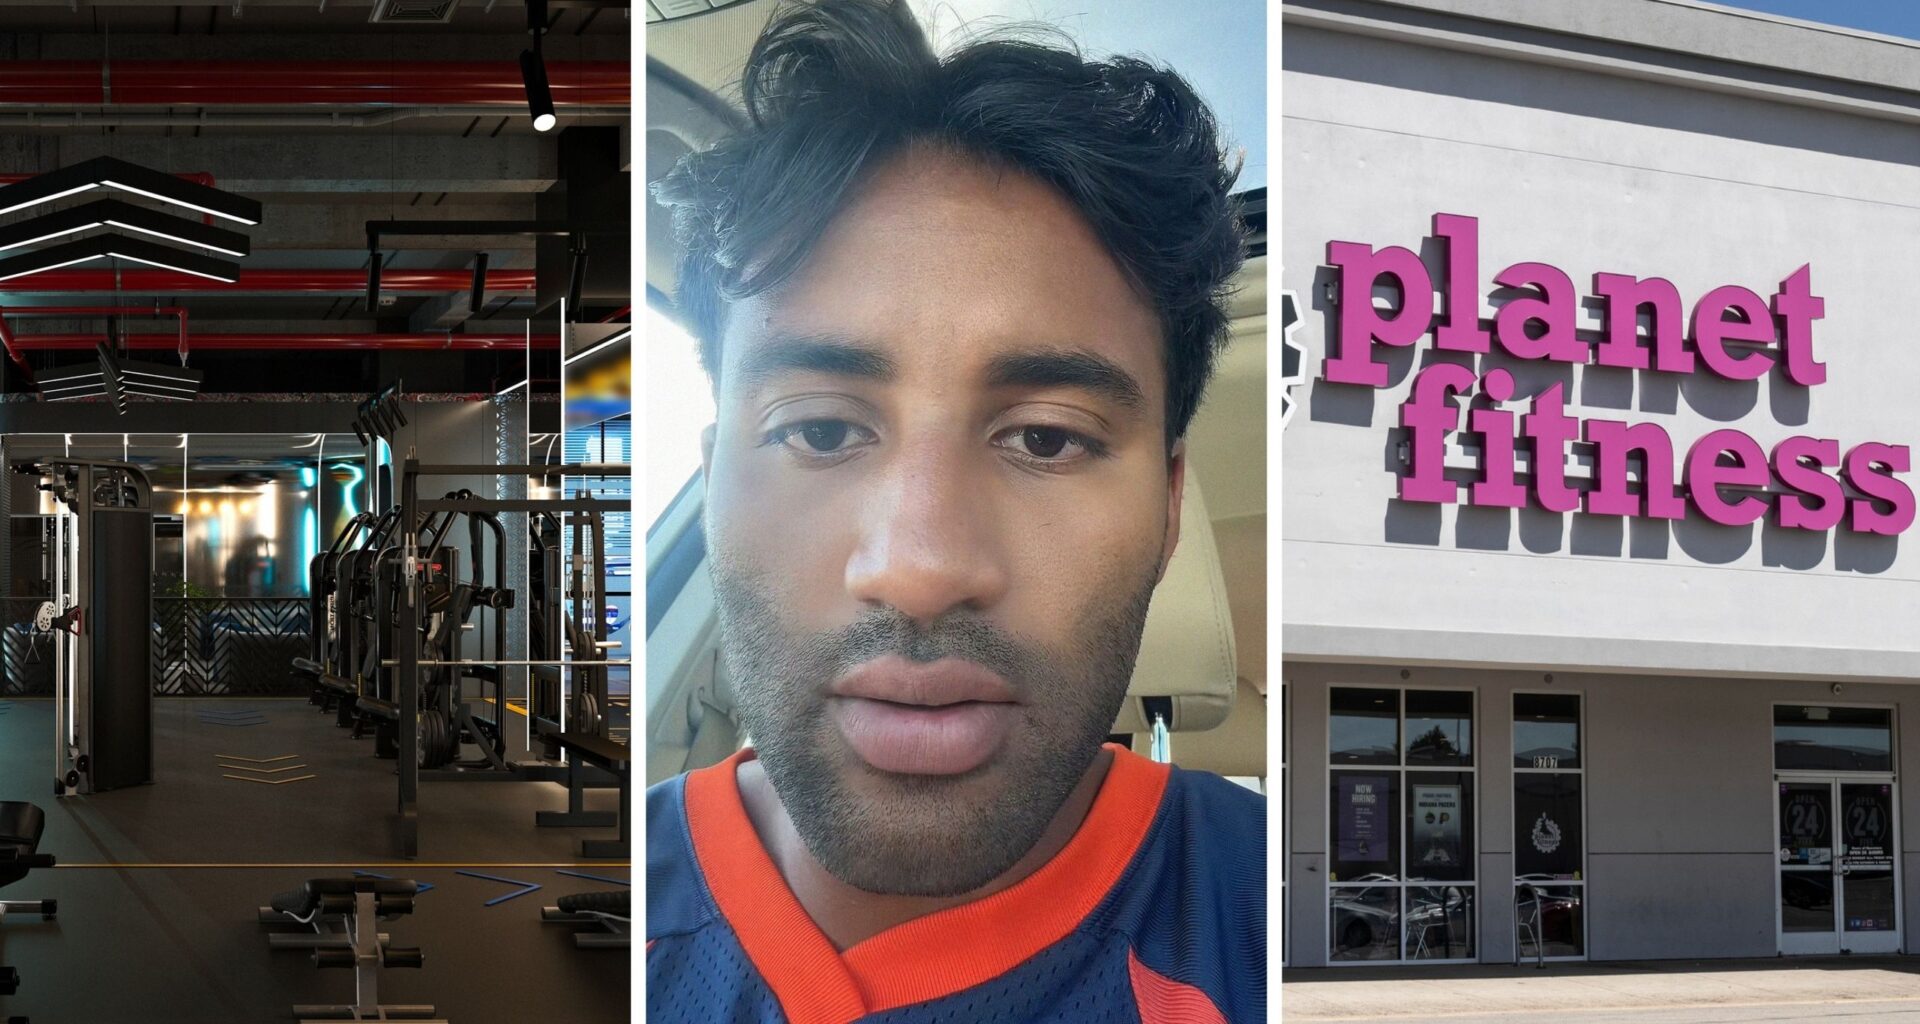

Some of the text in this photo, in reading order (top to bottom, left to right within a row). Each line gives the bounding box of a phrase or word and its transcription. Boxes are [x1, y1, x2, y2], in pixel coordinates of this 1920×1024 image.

[1322, 213, 1827, 386] planet
[1397, 362, 1917, 536] fitness
[1533, 756, 1557, 768] 8707
[1351, 794, 1376, 804] HIRING
[1355, 784, 1373, 794] NOW
[1792, 804, 1819, 836] 24
[1853, 806, 1880, 836] 24
